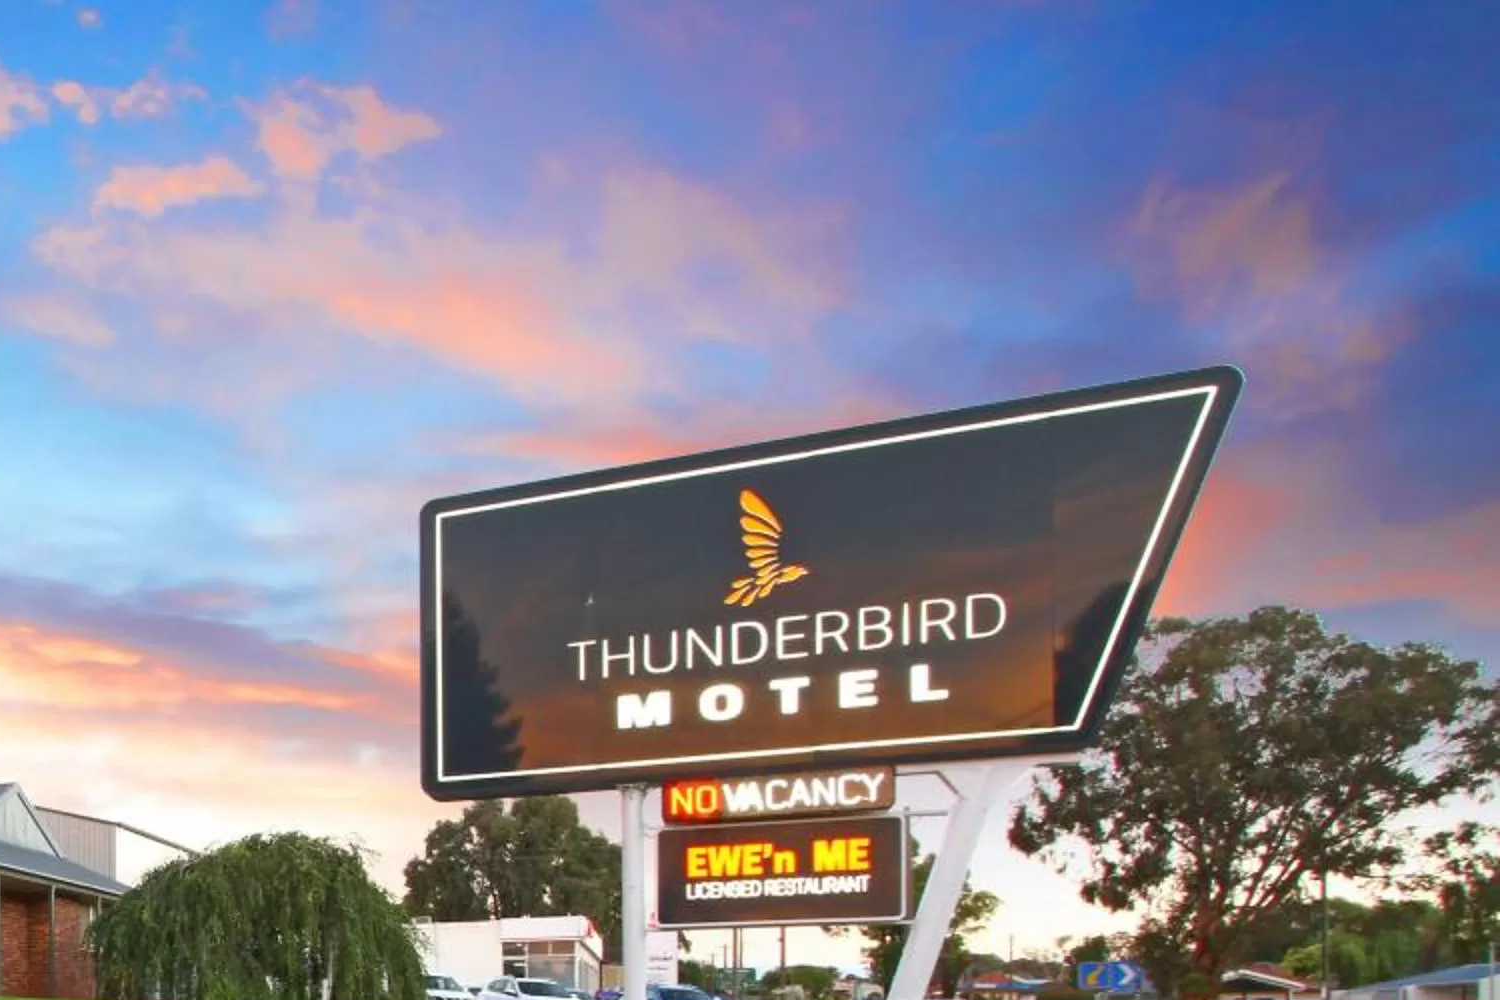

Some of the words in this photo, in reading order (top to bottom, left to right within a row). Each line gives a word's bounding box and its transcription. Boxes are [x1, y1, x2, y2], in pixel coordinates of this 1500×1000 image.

[566, 592, 1007, 681] THUNDERBIRD
[616, 663, 950, 729] MOTEL
[670, 785, 718, 815] NO
[722, 772, 885, 813] VACANCY
[686, 843, 797, 878] EWE'n
[813, 837, 871, 873] ME
[685, 879, 762, 900] LICENSED
[764, 874, 871, 897] RESTAURANT
